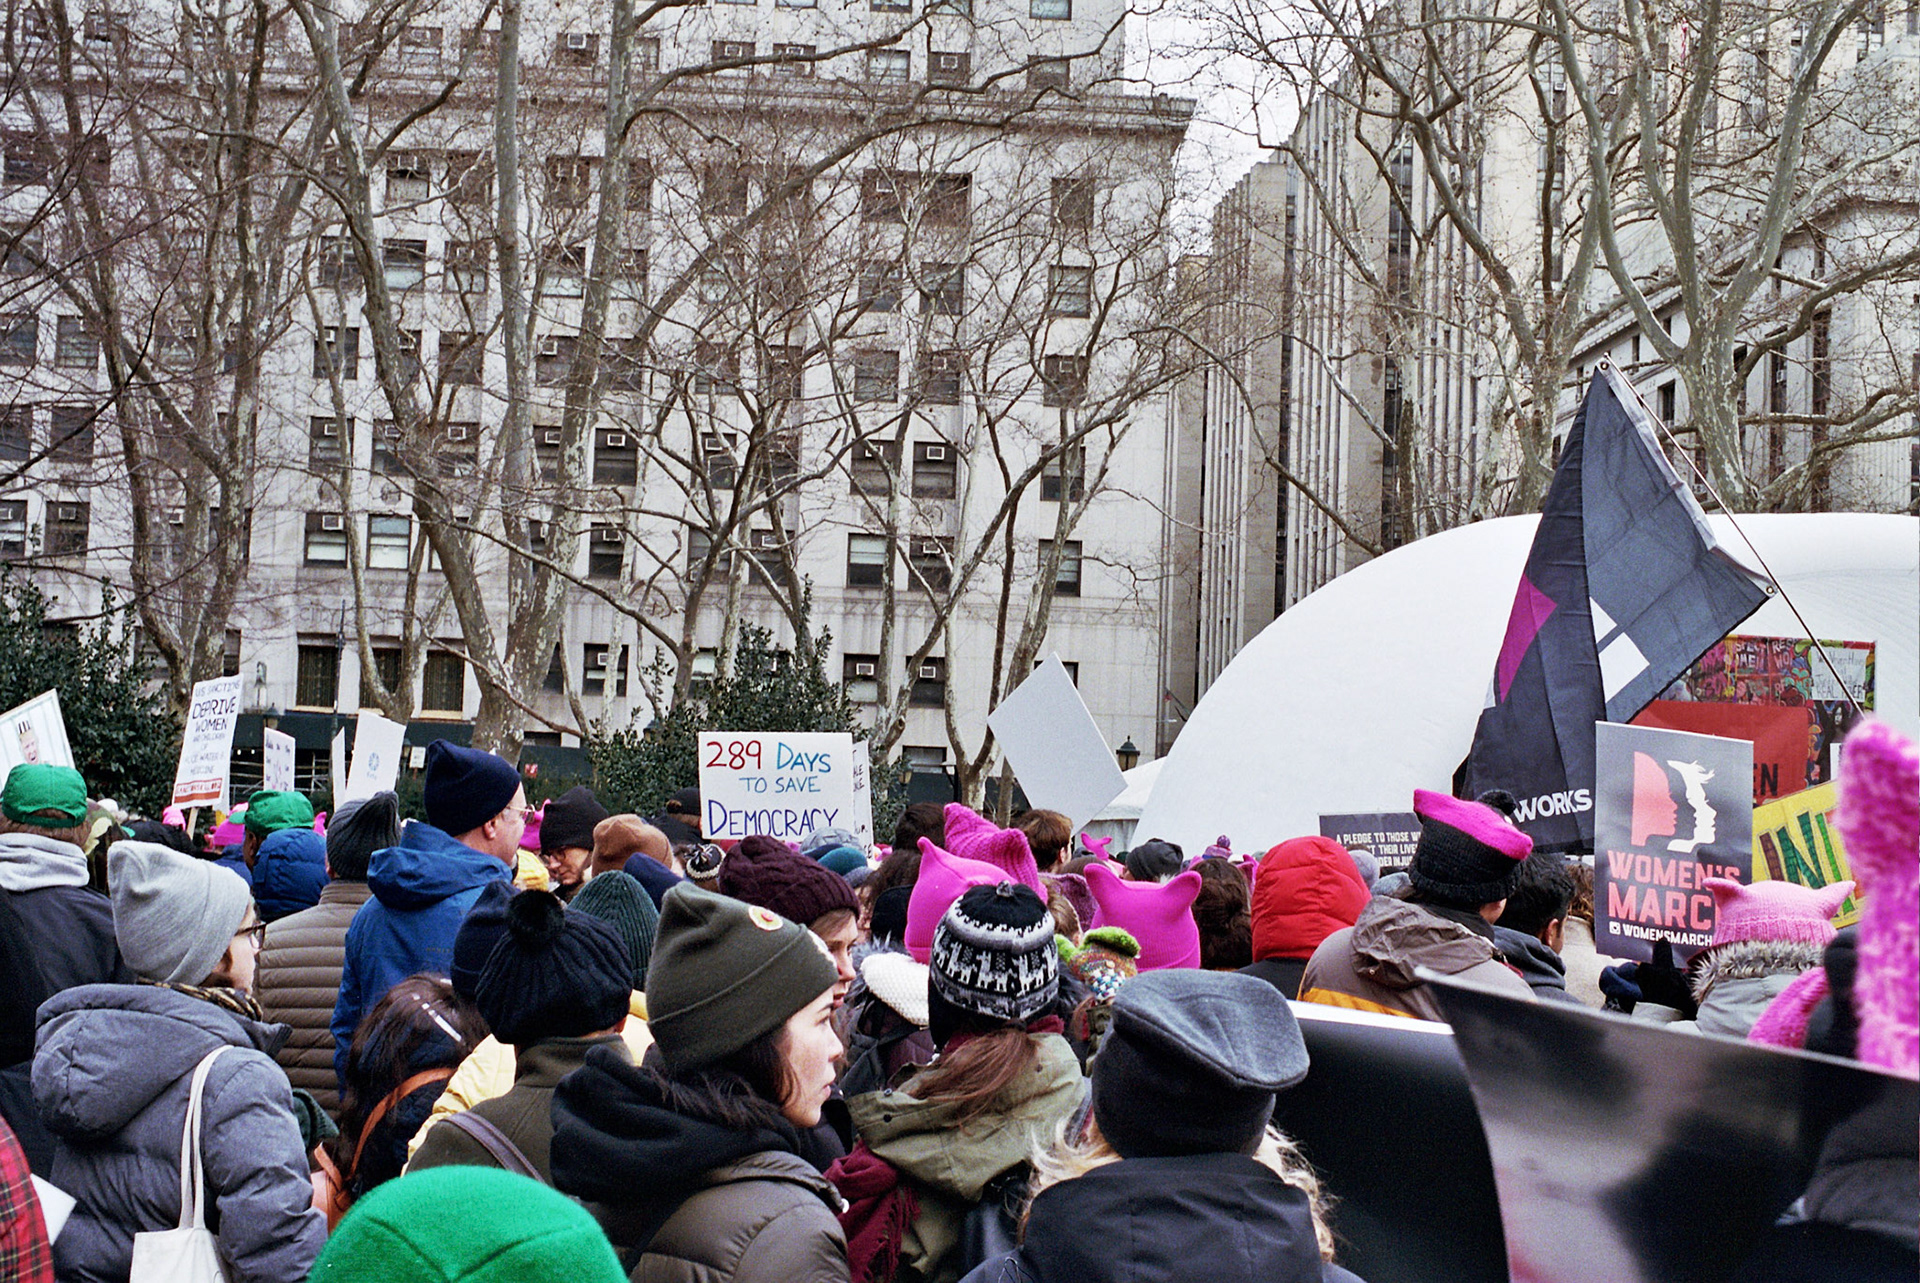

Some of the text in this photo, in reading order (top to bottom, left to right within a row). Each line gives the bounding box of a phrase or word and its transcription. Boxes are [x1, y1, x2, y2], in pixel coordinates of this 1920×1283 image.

[192, 696, 237, 720] DEPRIVE
[195, 718, 228, 733] WOMEN
[706, 740, 832, 773] 289 DAYS
[739, 776, 821, 793] TO SAVE
[1513, 788, 1593, 823] WORKS
[708, 799, 839, 837] DEMOCRACY
[1335, 834, 1342, 844] A
[1343, 832, 1372, 844] PLEDGE
[1374, 832, 1386, 843] TO
[1386, 831, 1409, 843] THOSE
[1378, 844, 1398, 855] THEIR
[1608, 850, 1741, 892] WOMEN'S
[1608, 881, 1721, 931] MARC
[1622, 923, 1713, 947] WOMENSMARCH
